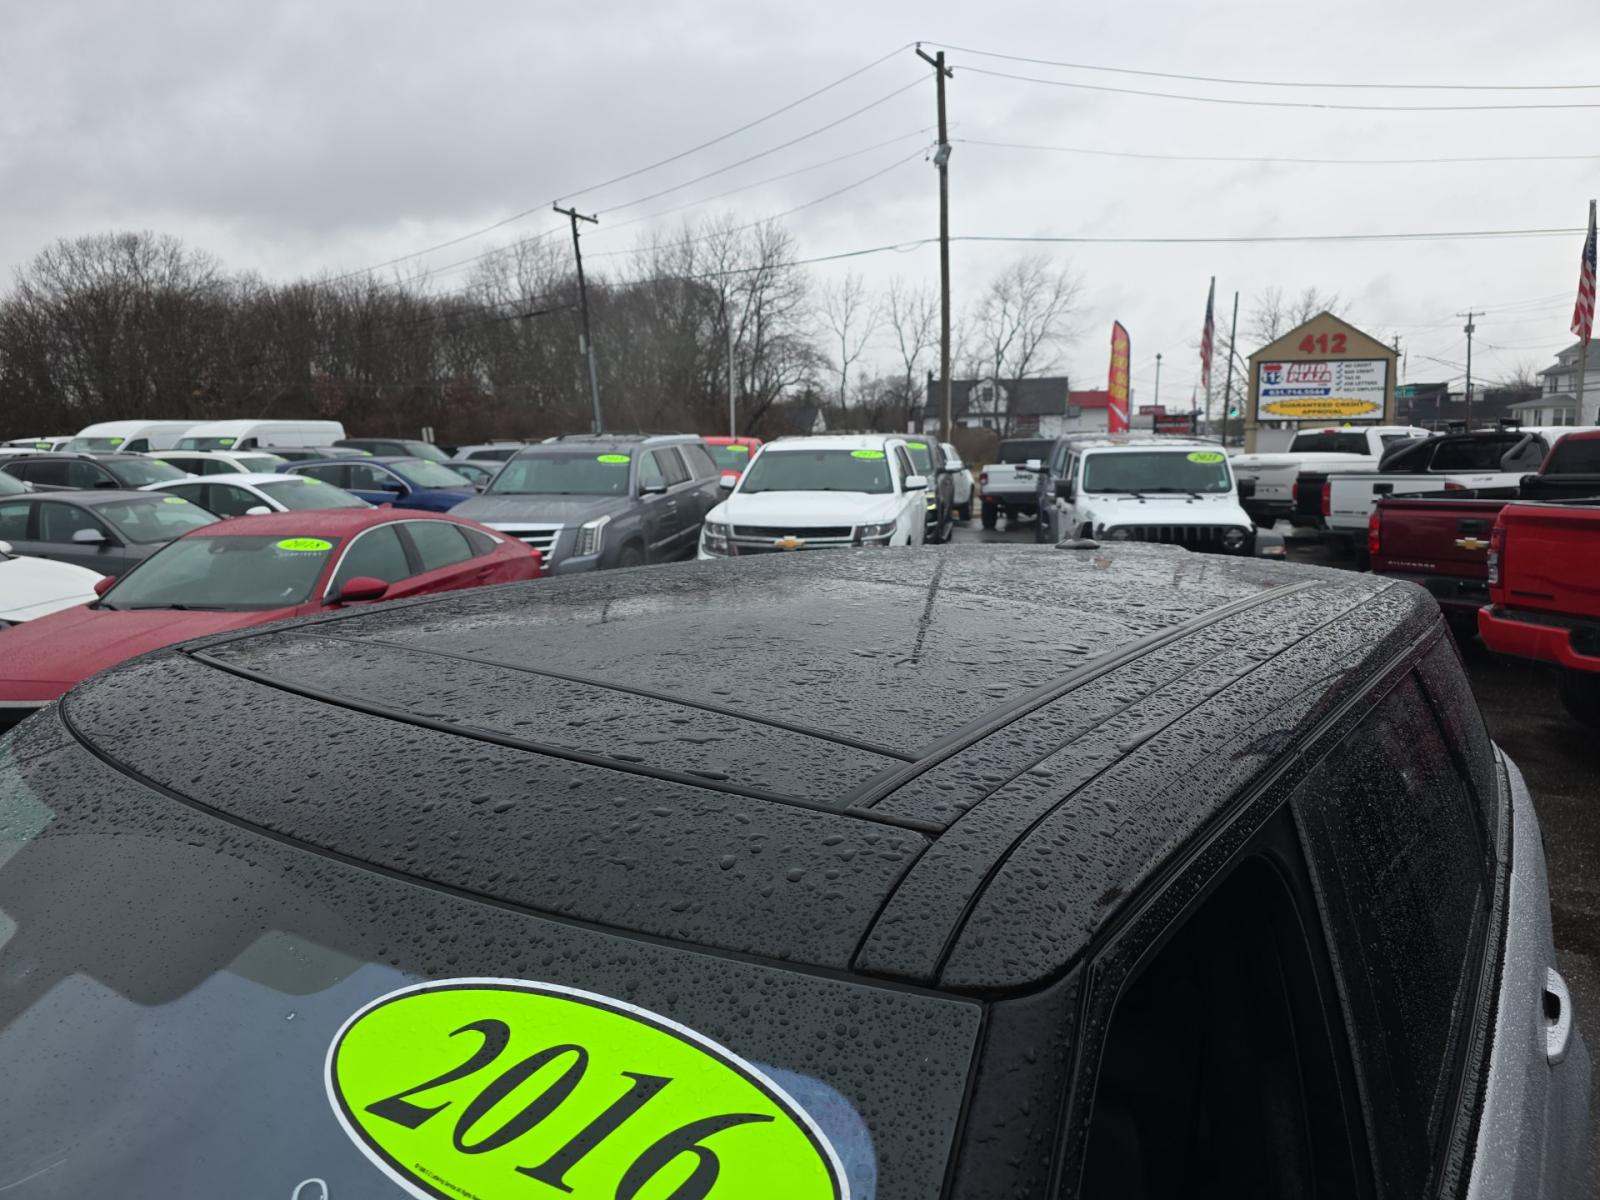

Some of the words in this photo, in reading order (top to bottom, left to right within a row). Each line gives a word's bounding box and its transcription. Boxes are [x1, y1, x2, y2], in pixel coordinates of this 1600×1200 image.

[1298, 332, 1347, 354] 412
[1291, 362, 1328, 373] AUTO
[1287, 371, 1332, 383] PLAZA
[363, 1018, 776, 1200] 2016
